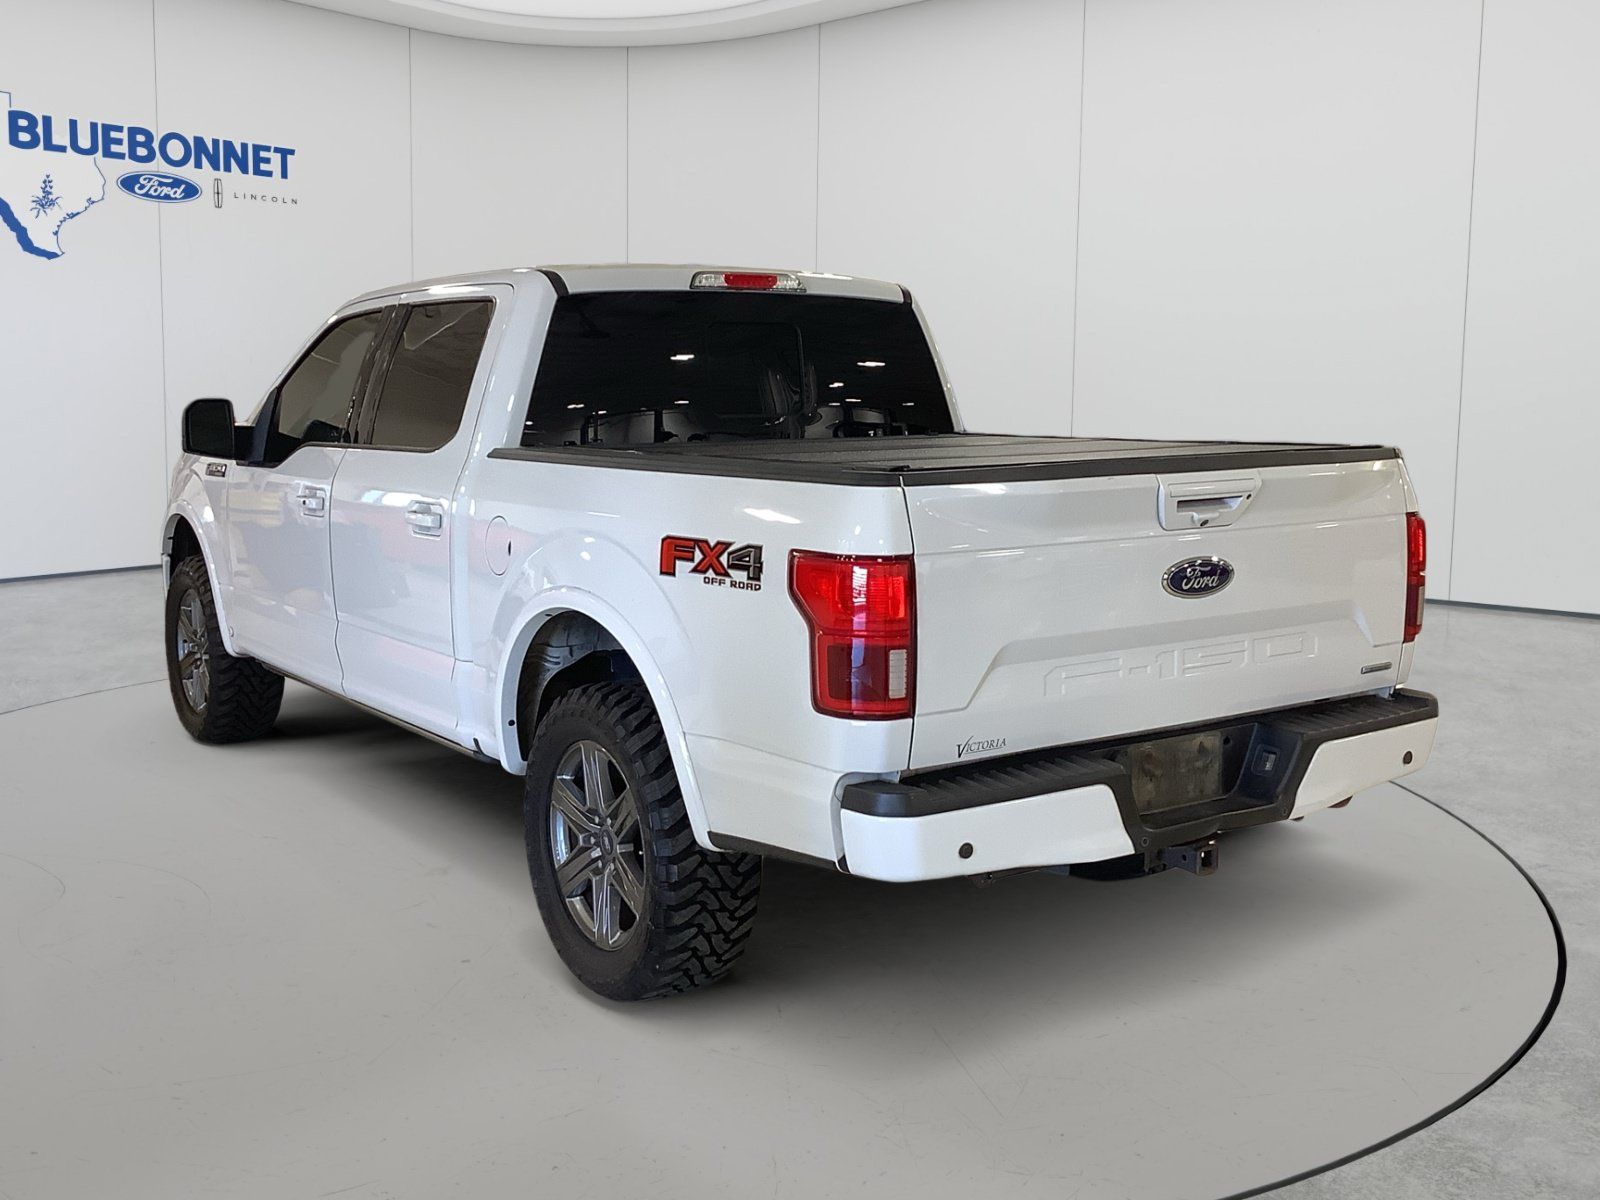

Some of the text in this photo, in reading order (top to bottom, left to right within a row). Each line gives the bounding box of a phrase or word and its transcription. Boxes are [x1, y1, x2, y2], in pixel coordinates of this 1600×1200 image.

[8, 110, 296, 180] BLUEBONNET
[134, 174, 186, 200] Ford
[233, 191, 299, 205] LINCOLN
[659, 534, 764, 583] FX4
[703, 576, 762, 592] OFF ROAD
[1181, 565, 1221, 590] Ford
[1044, 631, 1319, 697] F-150
[956, 735, 1007, 759] VICTORIA
